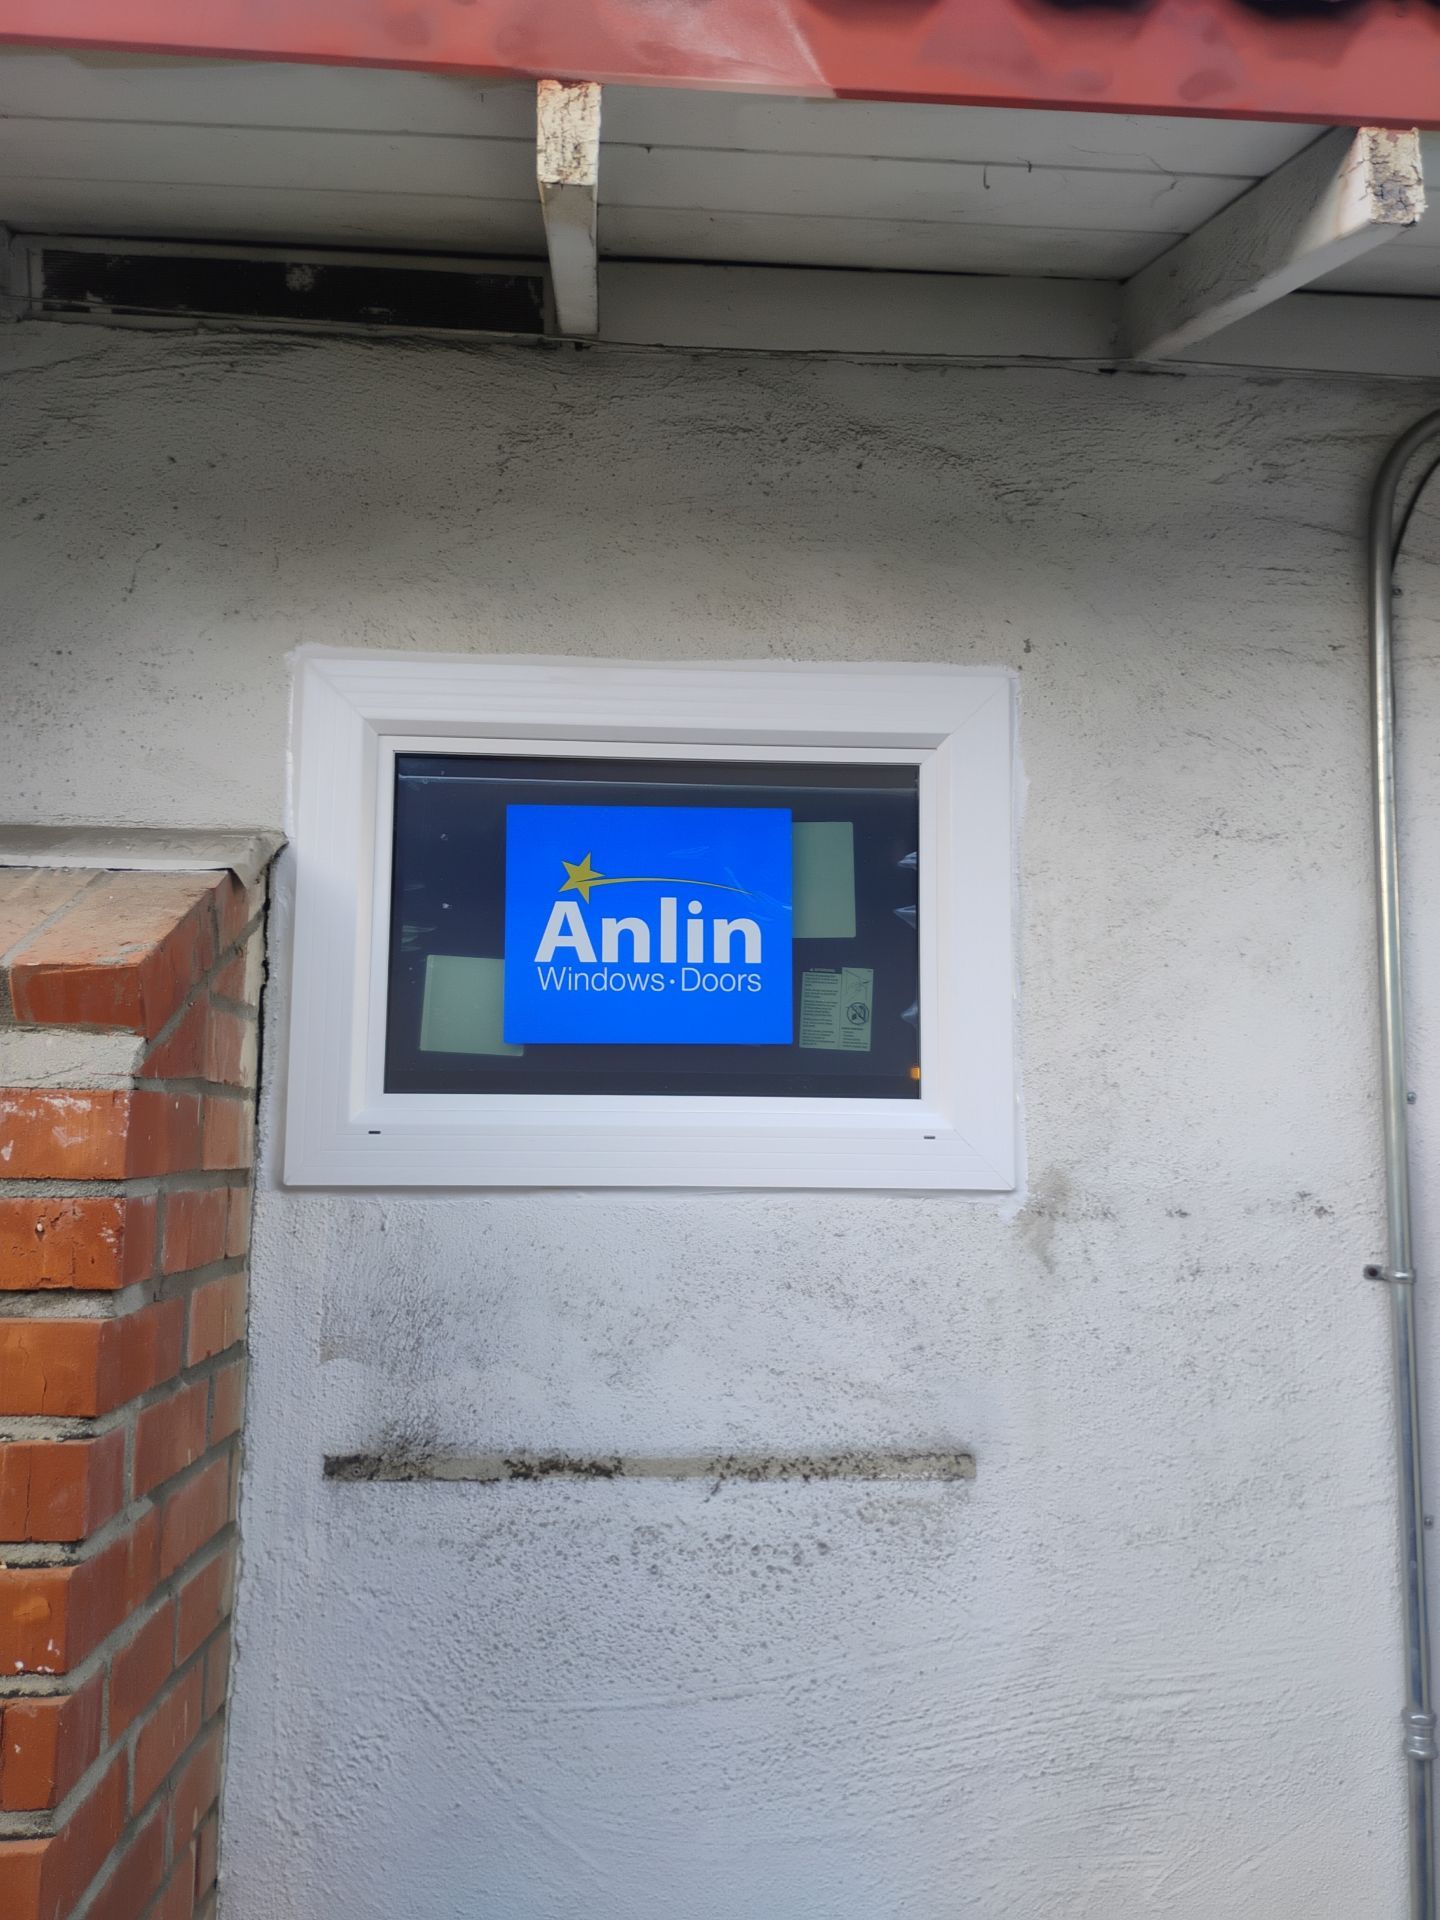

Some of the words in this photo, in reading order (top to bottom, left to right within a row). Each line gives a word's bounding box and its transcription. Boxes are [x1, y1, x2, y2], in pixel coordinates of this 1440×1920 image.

[534, 896, 762, 964] Anlin
[537, 966, 665, 992] Windows
[681, 967, 762, 992] Doors
